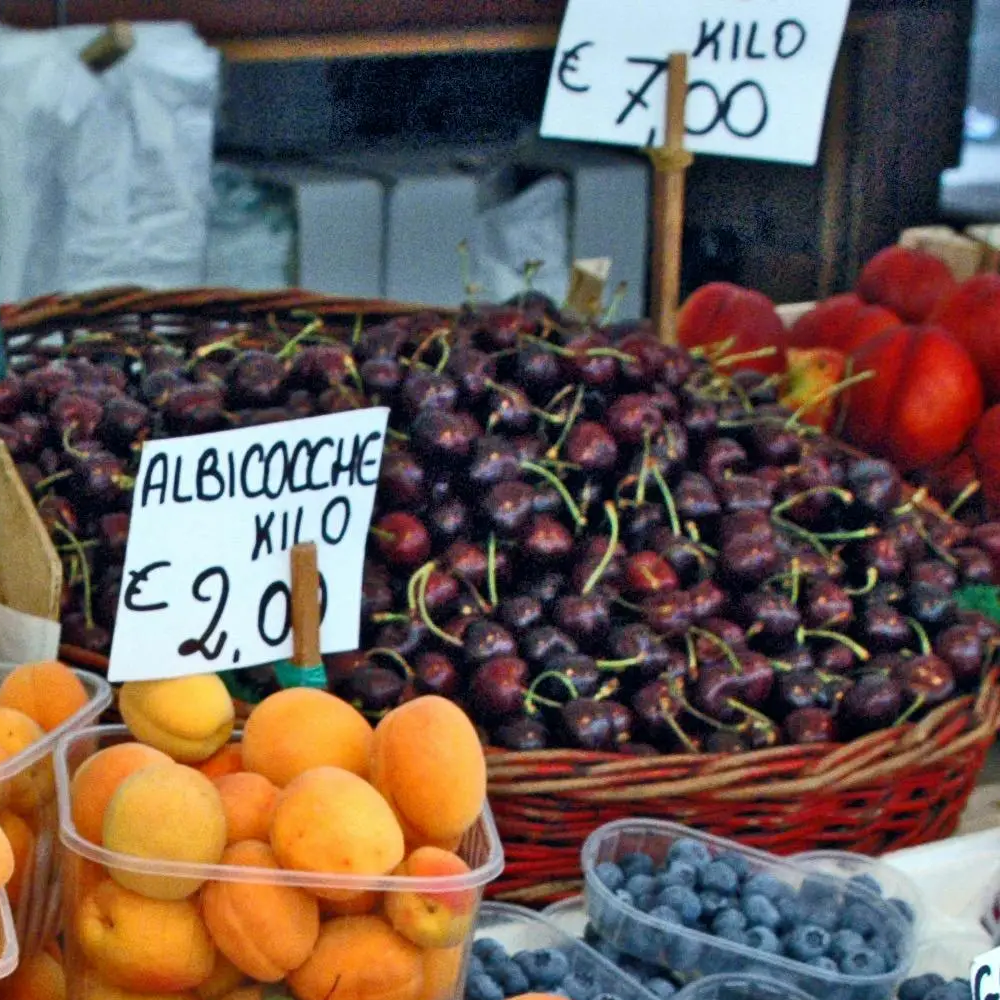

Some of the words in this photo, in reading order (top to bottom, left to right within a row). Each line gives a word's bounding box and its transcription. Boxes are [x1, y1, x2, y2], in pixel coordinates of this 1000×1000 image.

[692, 19, 807, 61] KILO
[558, 41, 595, 92] €
[141, 430, 381, 508] ALBICOCCHE
[251, 496, 351, 561] KILO
[124, 561, 171, 611] €
